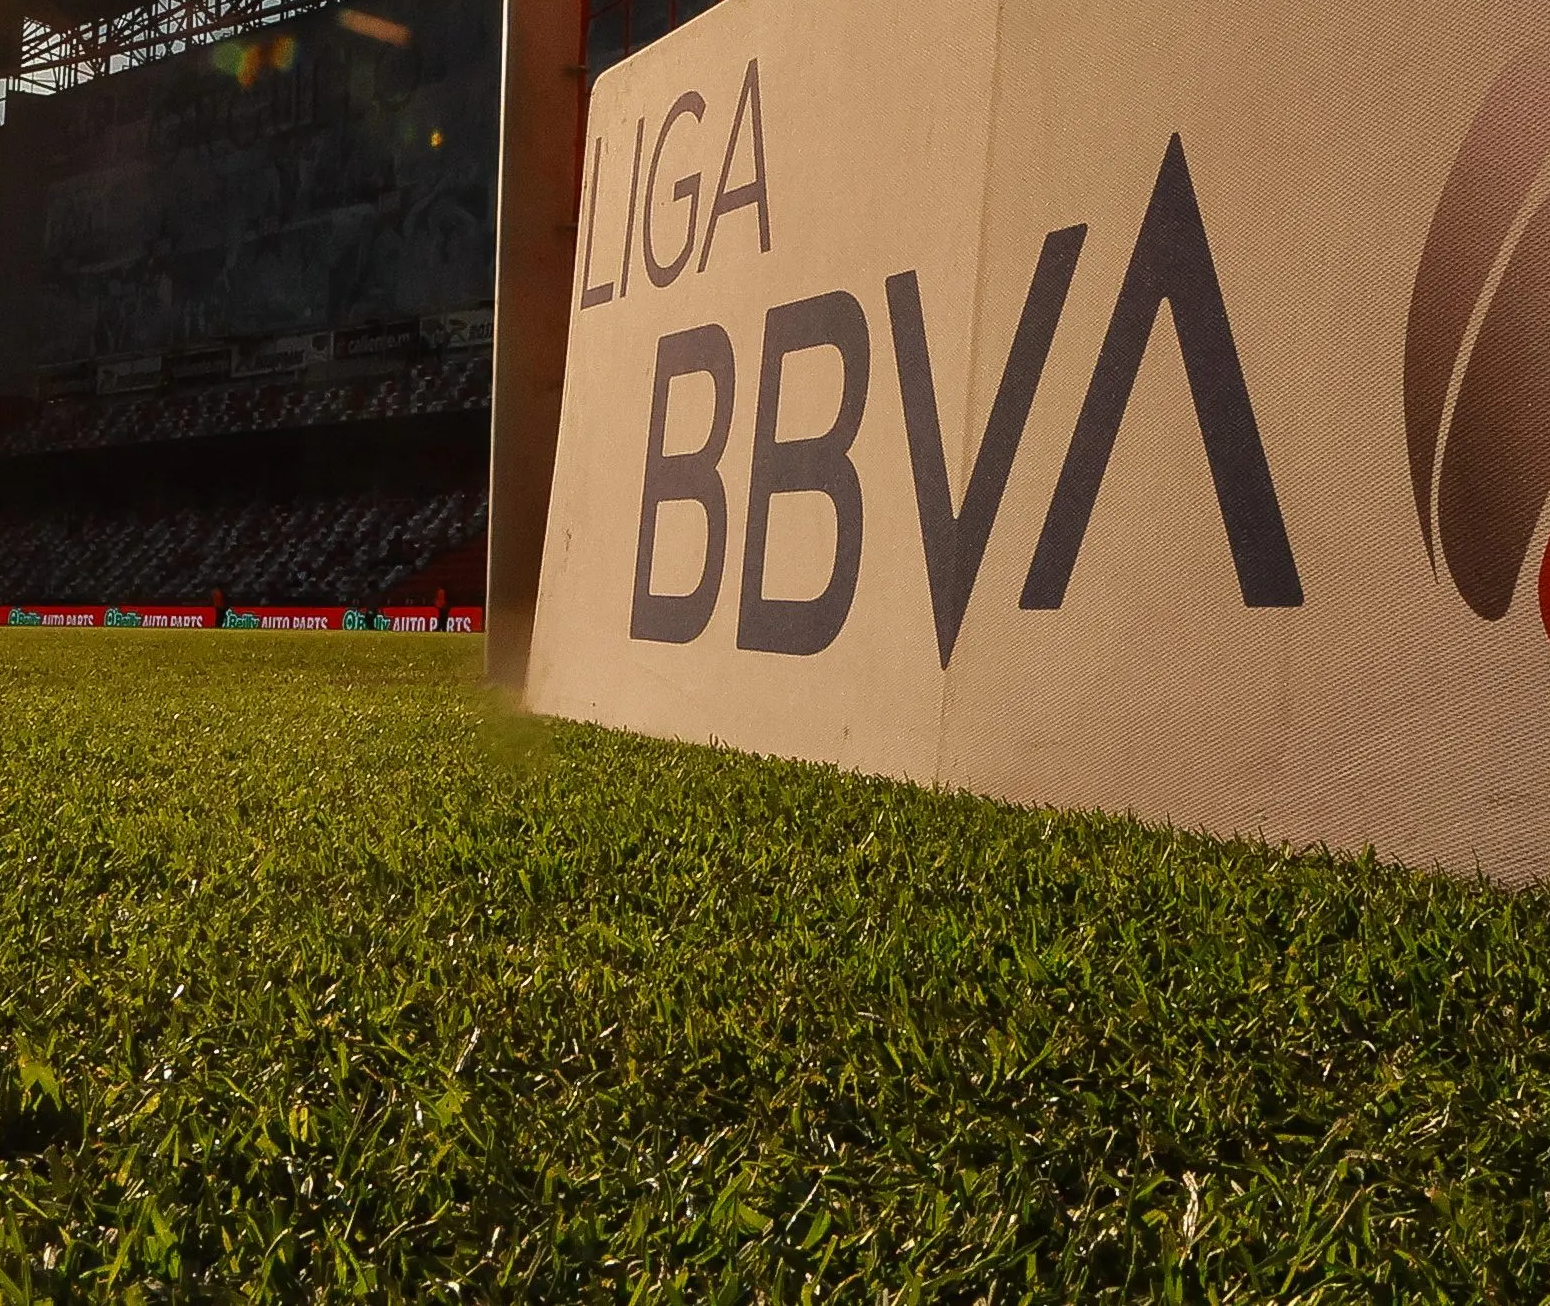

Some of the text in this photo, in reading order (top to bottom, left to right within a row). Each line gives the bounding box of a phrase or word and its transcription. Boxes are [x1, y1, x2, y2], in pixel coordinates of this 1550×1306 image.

[580, 59, 771, 310] LIGA
[630, 132, 1304, 670] BBVA
[427, 616, 472, 632] PRTS
